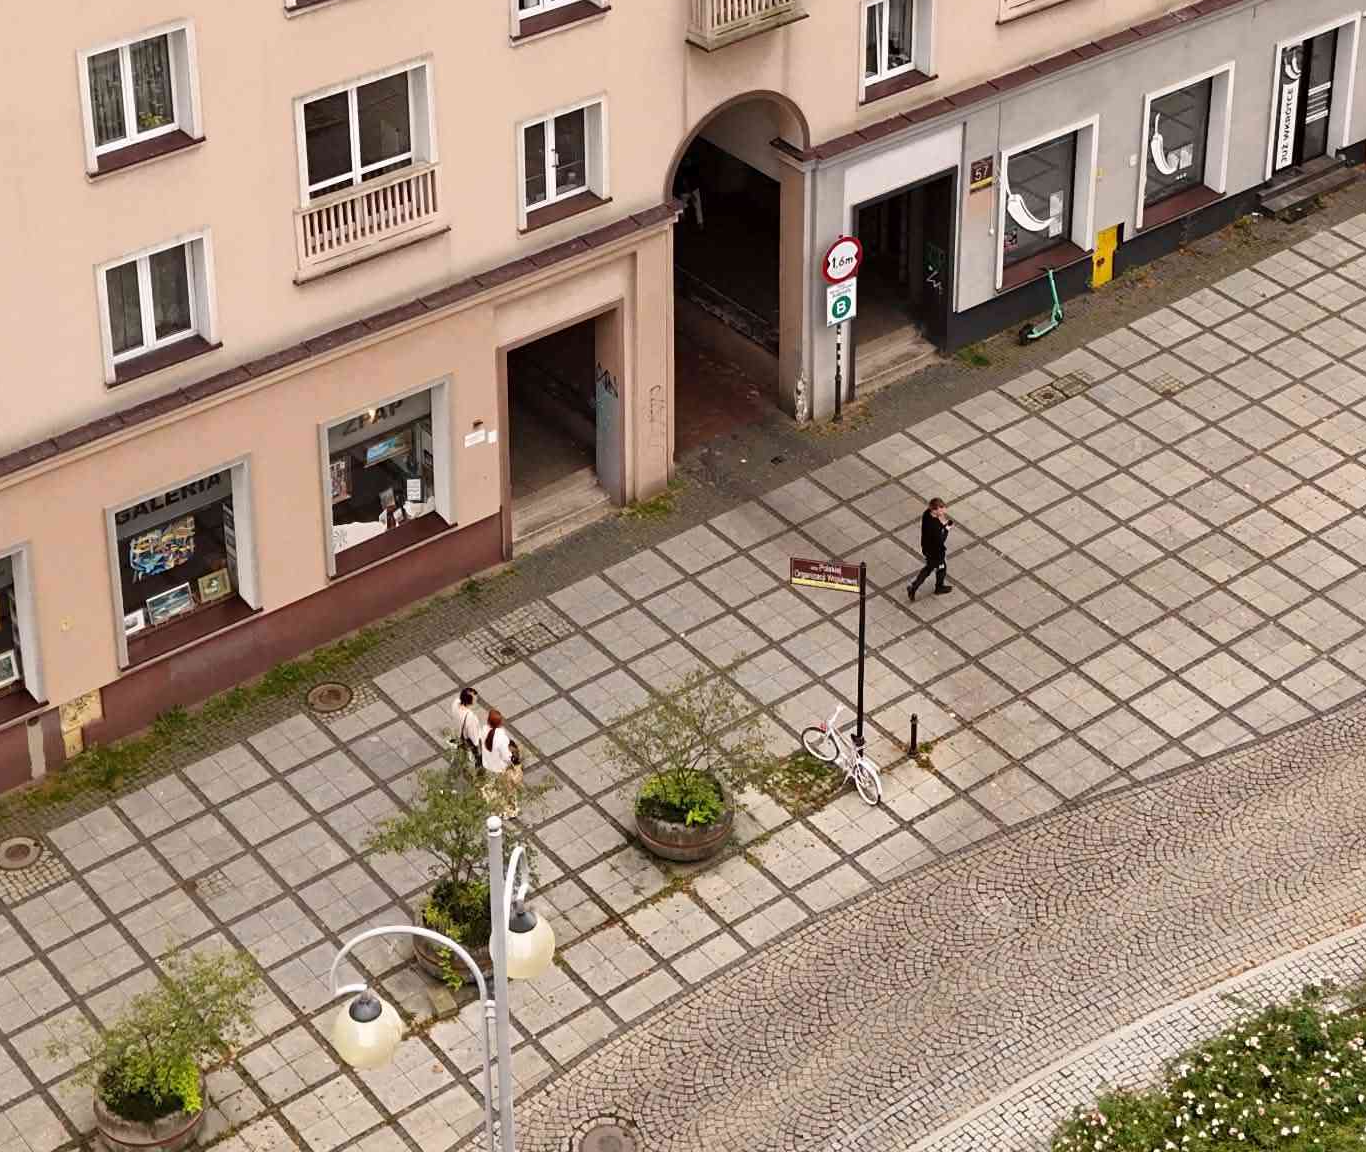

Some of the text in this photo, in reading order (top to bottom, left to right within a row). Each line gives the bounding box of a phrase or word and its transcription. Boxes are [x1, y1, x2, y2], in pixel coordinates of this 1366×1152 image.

[975, 166, 989, 181] 57
[837, 300, 846, 315] B
[116, 472, 220, 525] GALERIA
